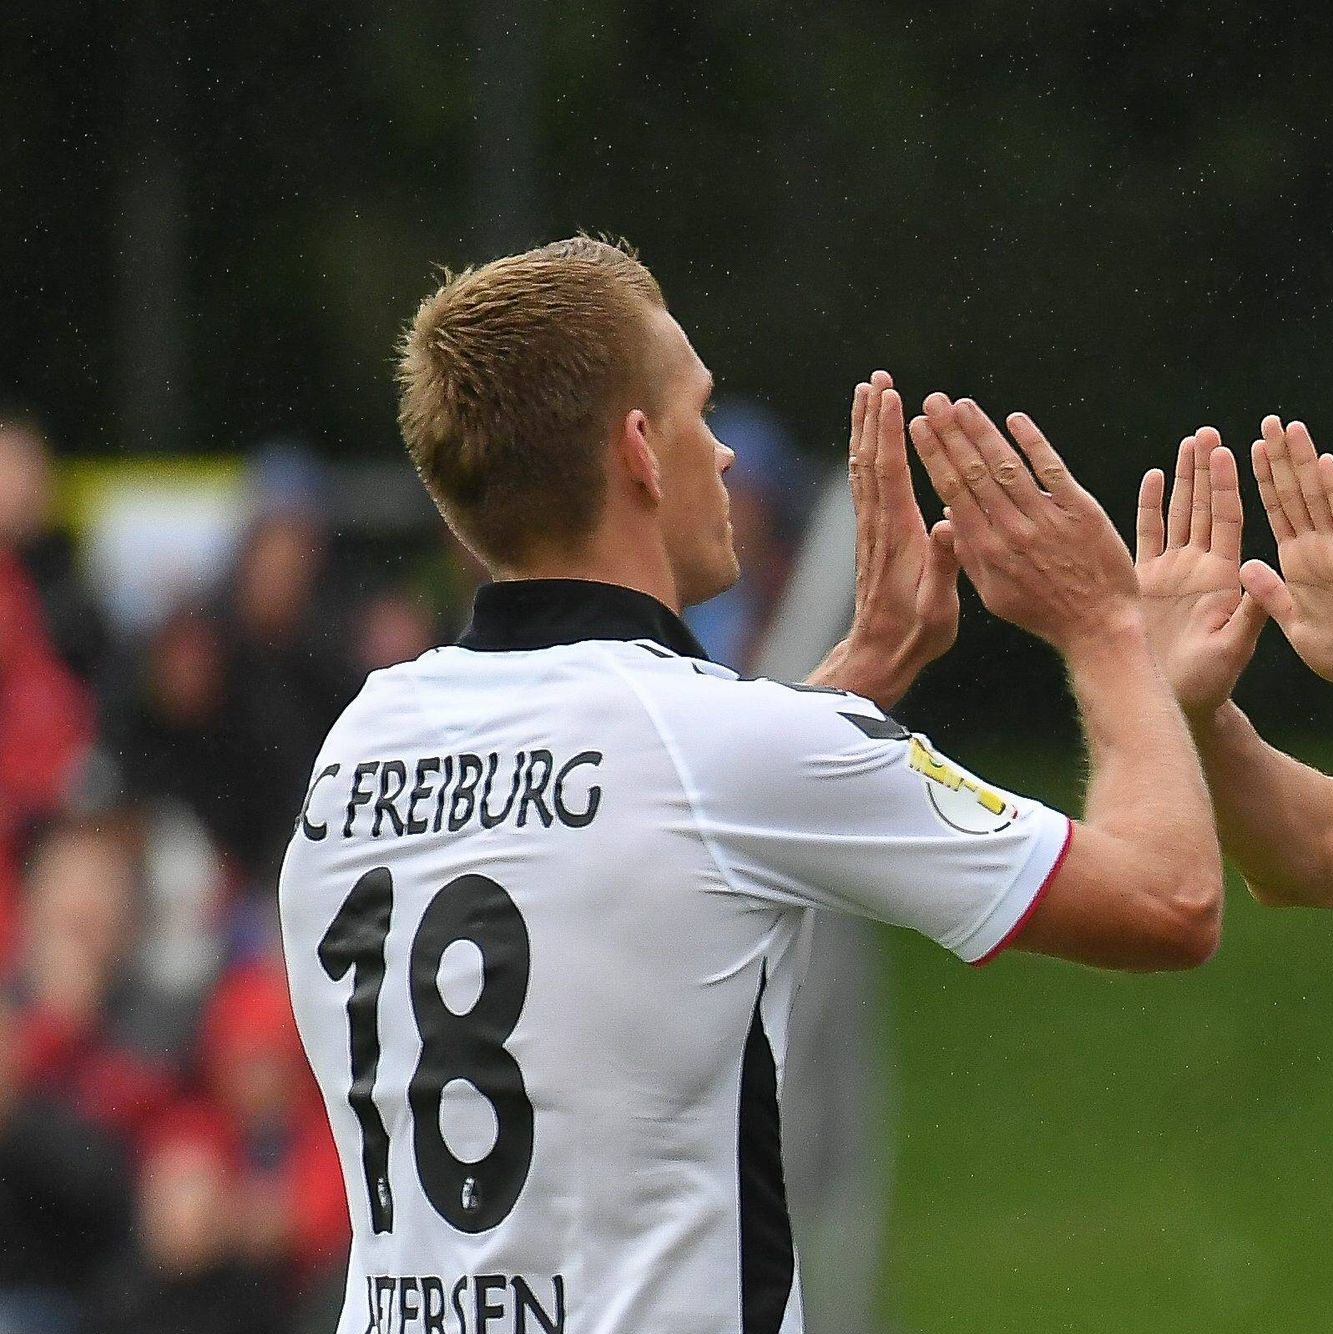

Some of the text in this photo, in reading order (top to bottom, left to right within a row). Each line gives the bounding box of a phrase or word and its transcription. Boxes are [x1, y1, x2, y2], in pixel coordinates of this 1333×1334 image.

[296, 749, 603, 842] C FREIBURG
[317, 866, 536, 1234] 18
